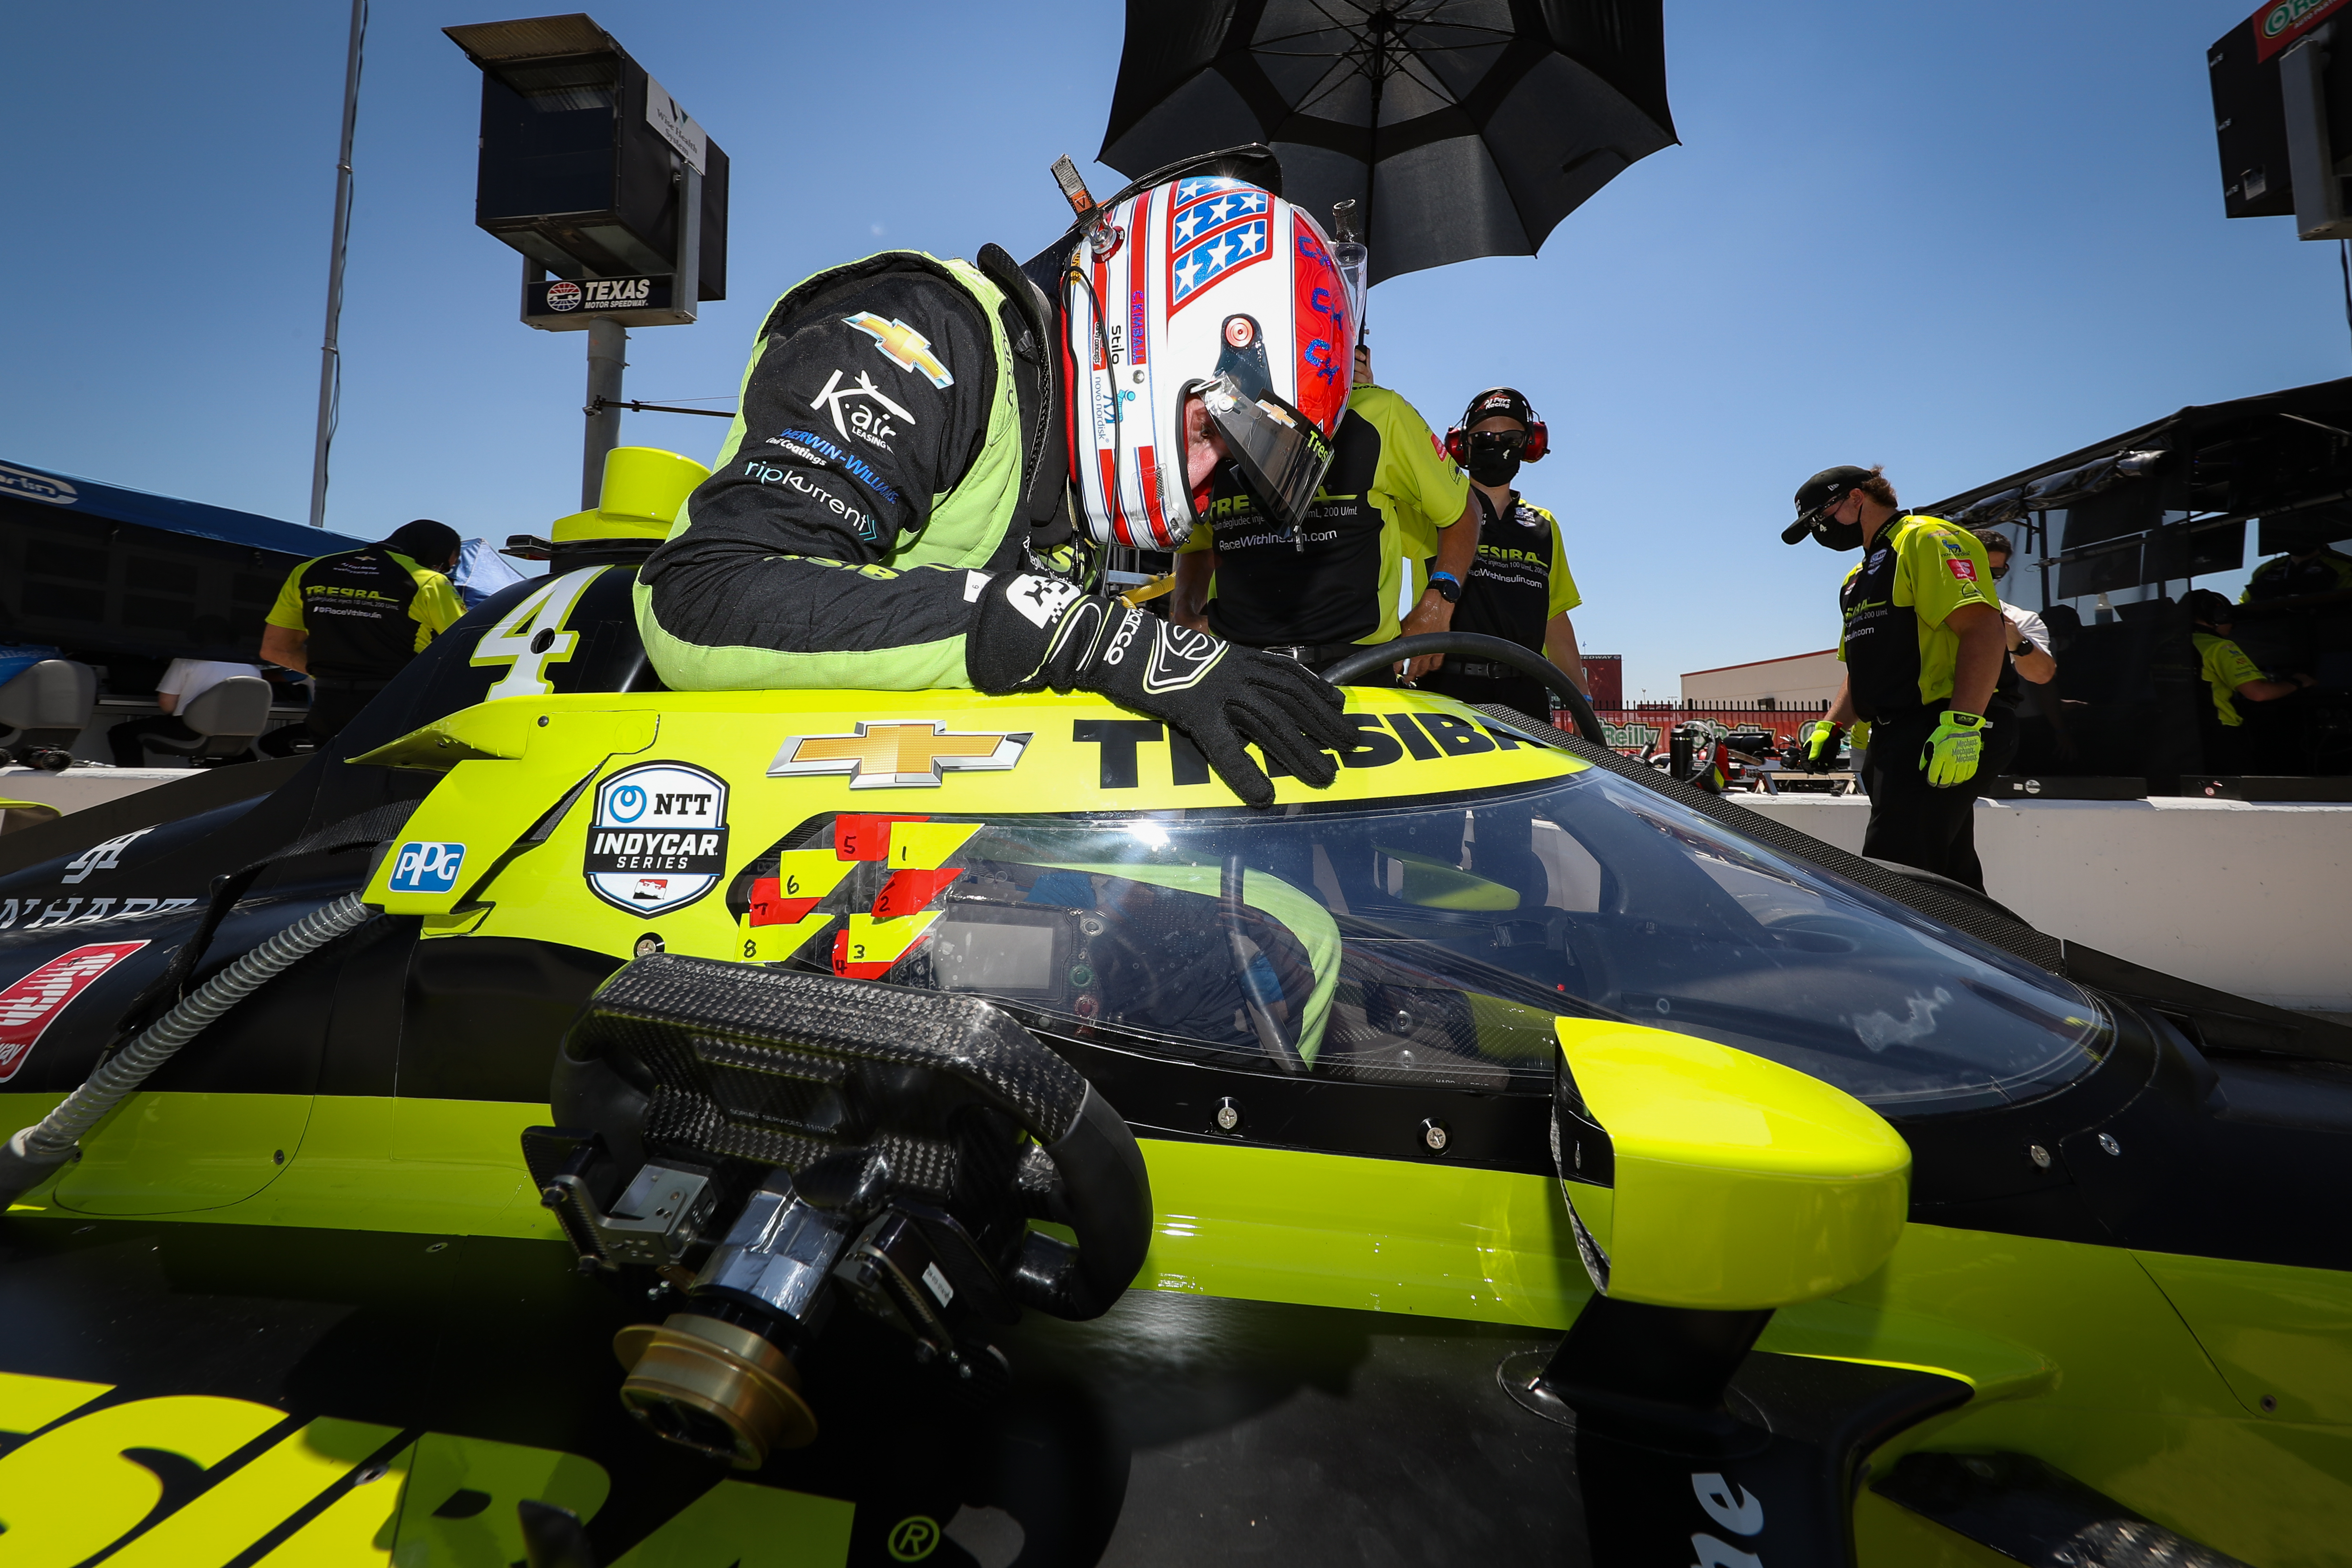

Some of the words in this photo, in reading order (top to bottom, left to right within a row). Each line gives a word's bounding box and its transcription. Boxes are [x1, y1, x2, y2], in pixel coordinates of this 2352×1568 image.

[656, 108, 675, 131] Wise
[676, 127, 698, 154] Health
[665, 128, 689, 156] System
[585, 279, 650, 301] TEXAS
[610, 300, 647, 308] SPEEDWAY
[1132, 303, 1145, 364] KIMBALL
[1111, 325, 1124, 365] Stilo
[1096, 404, 1106, 440] nordisk
[852, 426, 886, 448] LEASING
[780, 439, 827, 466] Coatings
[1502, 449, 1510, 459] 4
[1324, 507, 1339, 518] 200
[1341, 506, 1358, 517] U/mL
[1820, 524, 1827, 532] 4
[1478, 545, 1548, 568] ESIBA
[1468, 568, 1542, 589] aceWithInsulin.com
[1864, 611, 1875, 619] 200
[469, 564, 615, 701] 4
[1598, 720, 1656, 744] 'Reilly
[1072, 713, 1551, 789] TSIBA
[654, 793, 712, 816] NTT
[593, 833, 718, 856] INDYCAR
[843, 836, 856, 854] 5
[902, 846, 907, 862] 1
[395, 843, 461, 886] PPG
[616, 857, 688, 870] SERIES
[787, 875, 799, 894] 6
[754, 902, 768, 916] 7
[880, 896, 889, 912] 2
[744, 939, 756, 958] 8
[853, 945, 865, 959] 3
[834, 958, 846, 975] 4
